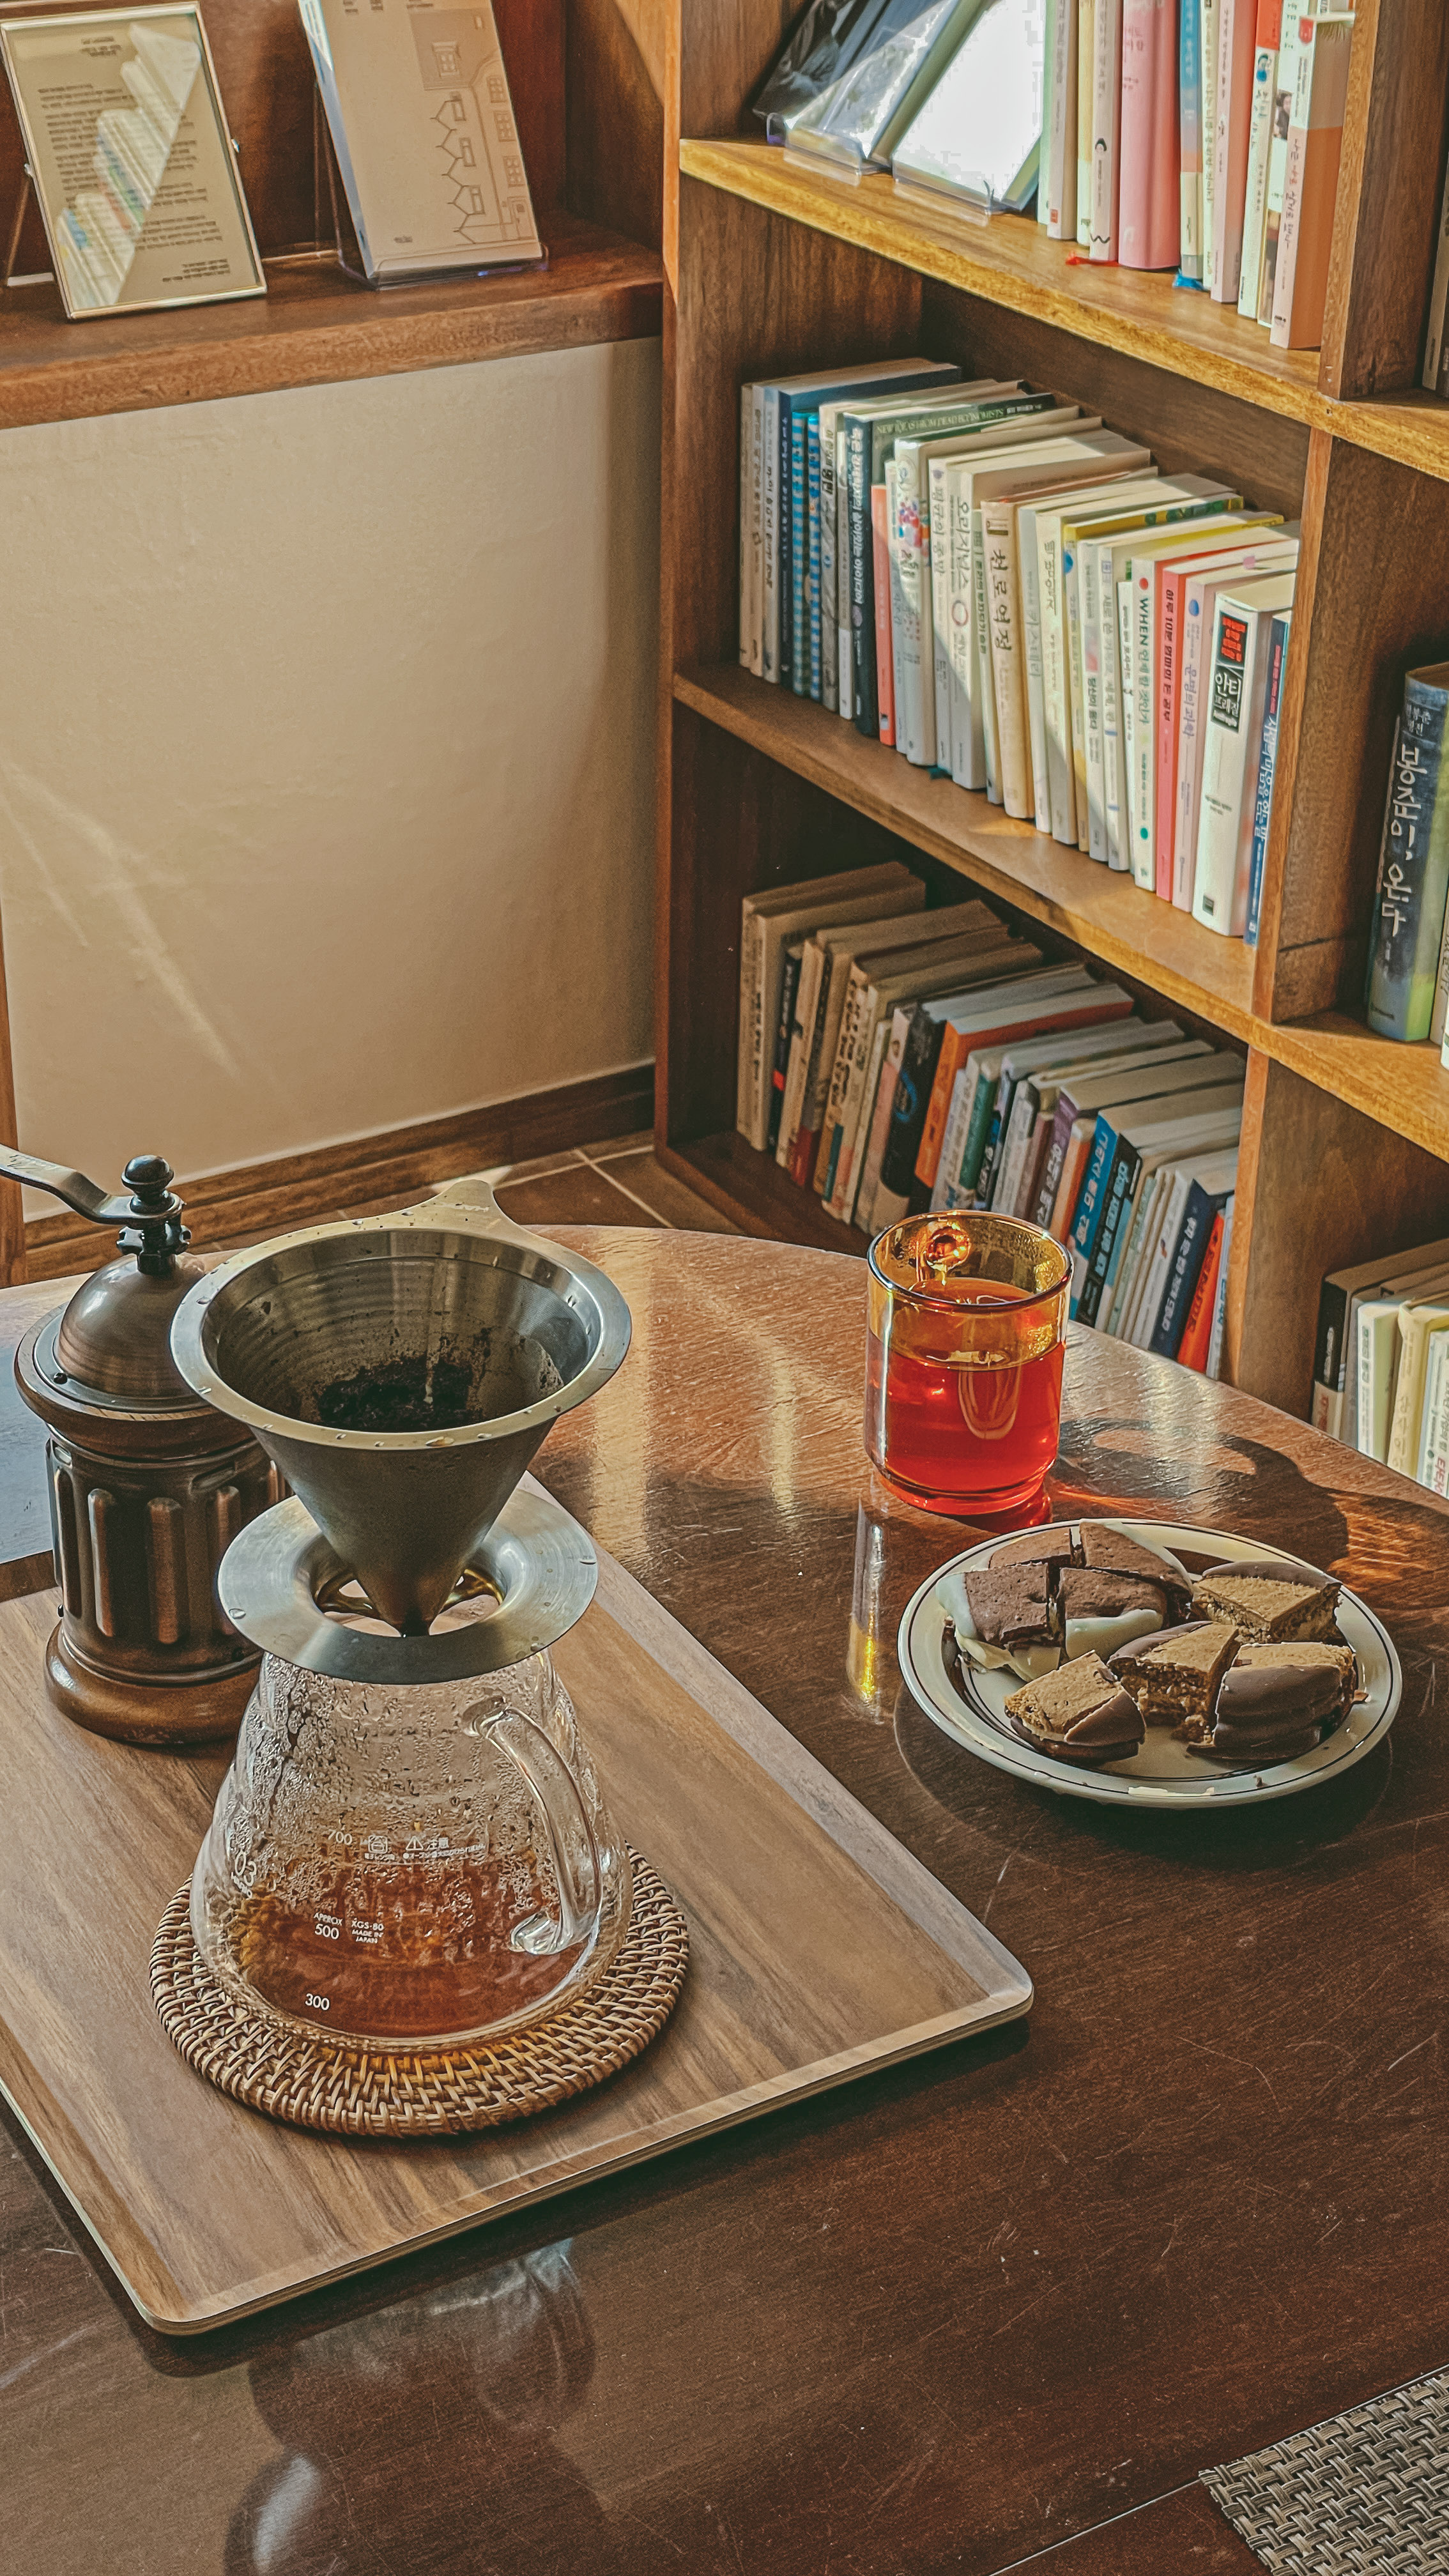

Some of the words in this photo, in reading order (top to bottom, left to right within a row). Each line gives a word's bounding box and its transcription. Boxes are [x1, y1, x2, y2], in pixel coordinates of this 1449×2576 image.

[854, 558, 864, 604] 아이디어
[1138, 598, 1149, 646] WHEN
[1183, 664, 1197, 705] 운명의
[1215, 673, 1241, 700] 안티
[1215, 697, 1239, 717] 프래질
[1259, 758, 1274, 799] 마음을
[328, 1830, 353, 1845] 700
[314, 1913, 342, 1926] APPROX
[351, 1920, 384, 1931] XGS-80
[315, 1924, 339, 1940] 500
[305, 1992, 330, 2011] 300
